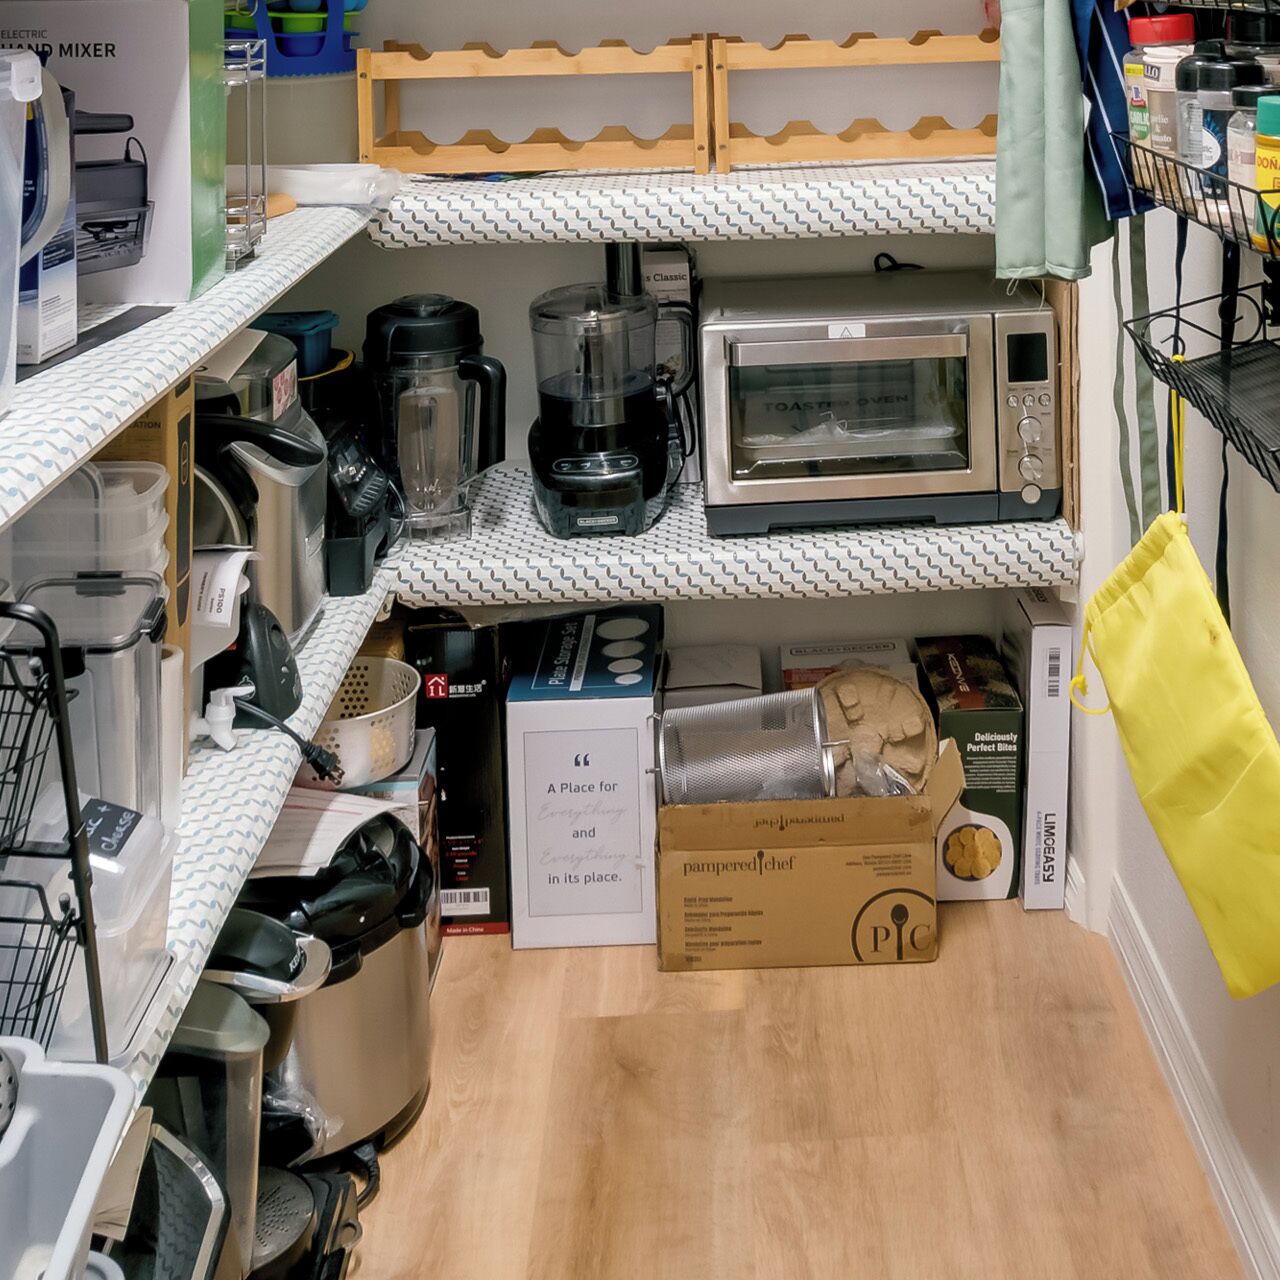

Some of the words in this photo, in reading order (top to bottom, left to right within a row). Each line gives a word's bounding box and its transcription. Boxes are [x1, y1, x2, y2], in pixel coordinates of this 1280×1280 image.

[0, 29, 48, 39] ELECTRIC
[58, 43, 116, 58] MIXER
[653, 272, 688, 282] Classic
[857, 394, 909, 407] OVEN
[548, 660, 568, 686] Plate
[974, 732, 1018, 744] Deliciously
[966, 743, 996, 752] Perfect
[996, 742, 1018, 752] Bites
[547, 783, 557, 795] A
[560, 782, 596, 795] Place
[599, 780, 619, 793] for
[785, 814, 846, 829] pampered
[571, 826, 597, 839] and
[1042, 812, 1057, 883] LIMOEASY
[683, 857, 757, 877] pampered
[763, 855, 797, 872] chef
[548, 872, 560, 885] in
[563, 872, 581, 884] its
[583, 871, 623, 886] place.
[871, 925, 891, 953] P
[910, 924, 932, 952] C
